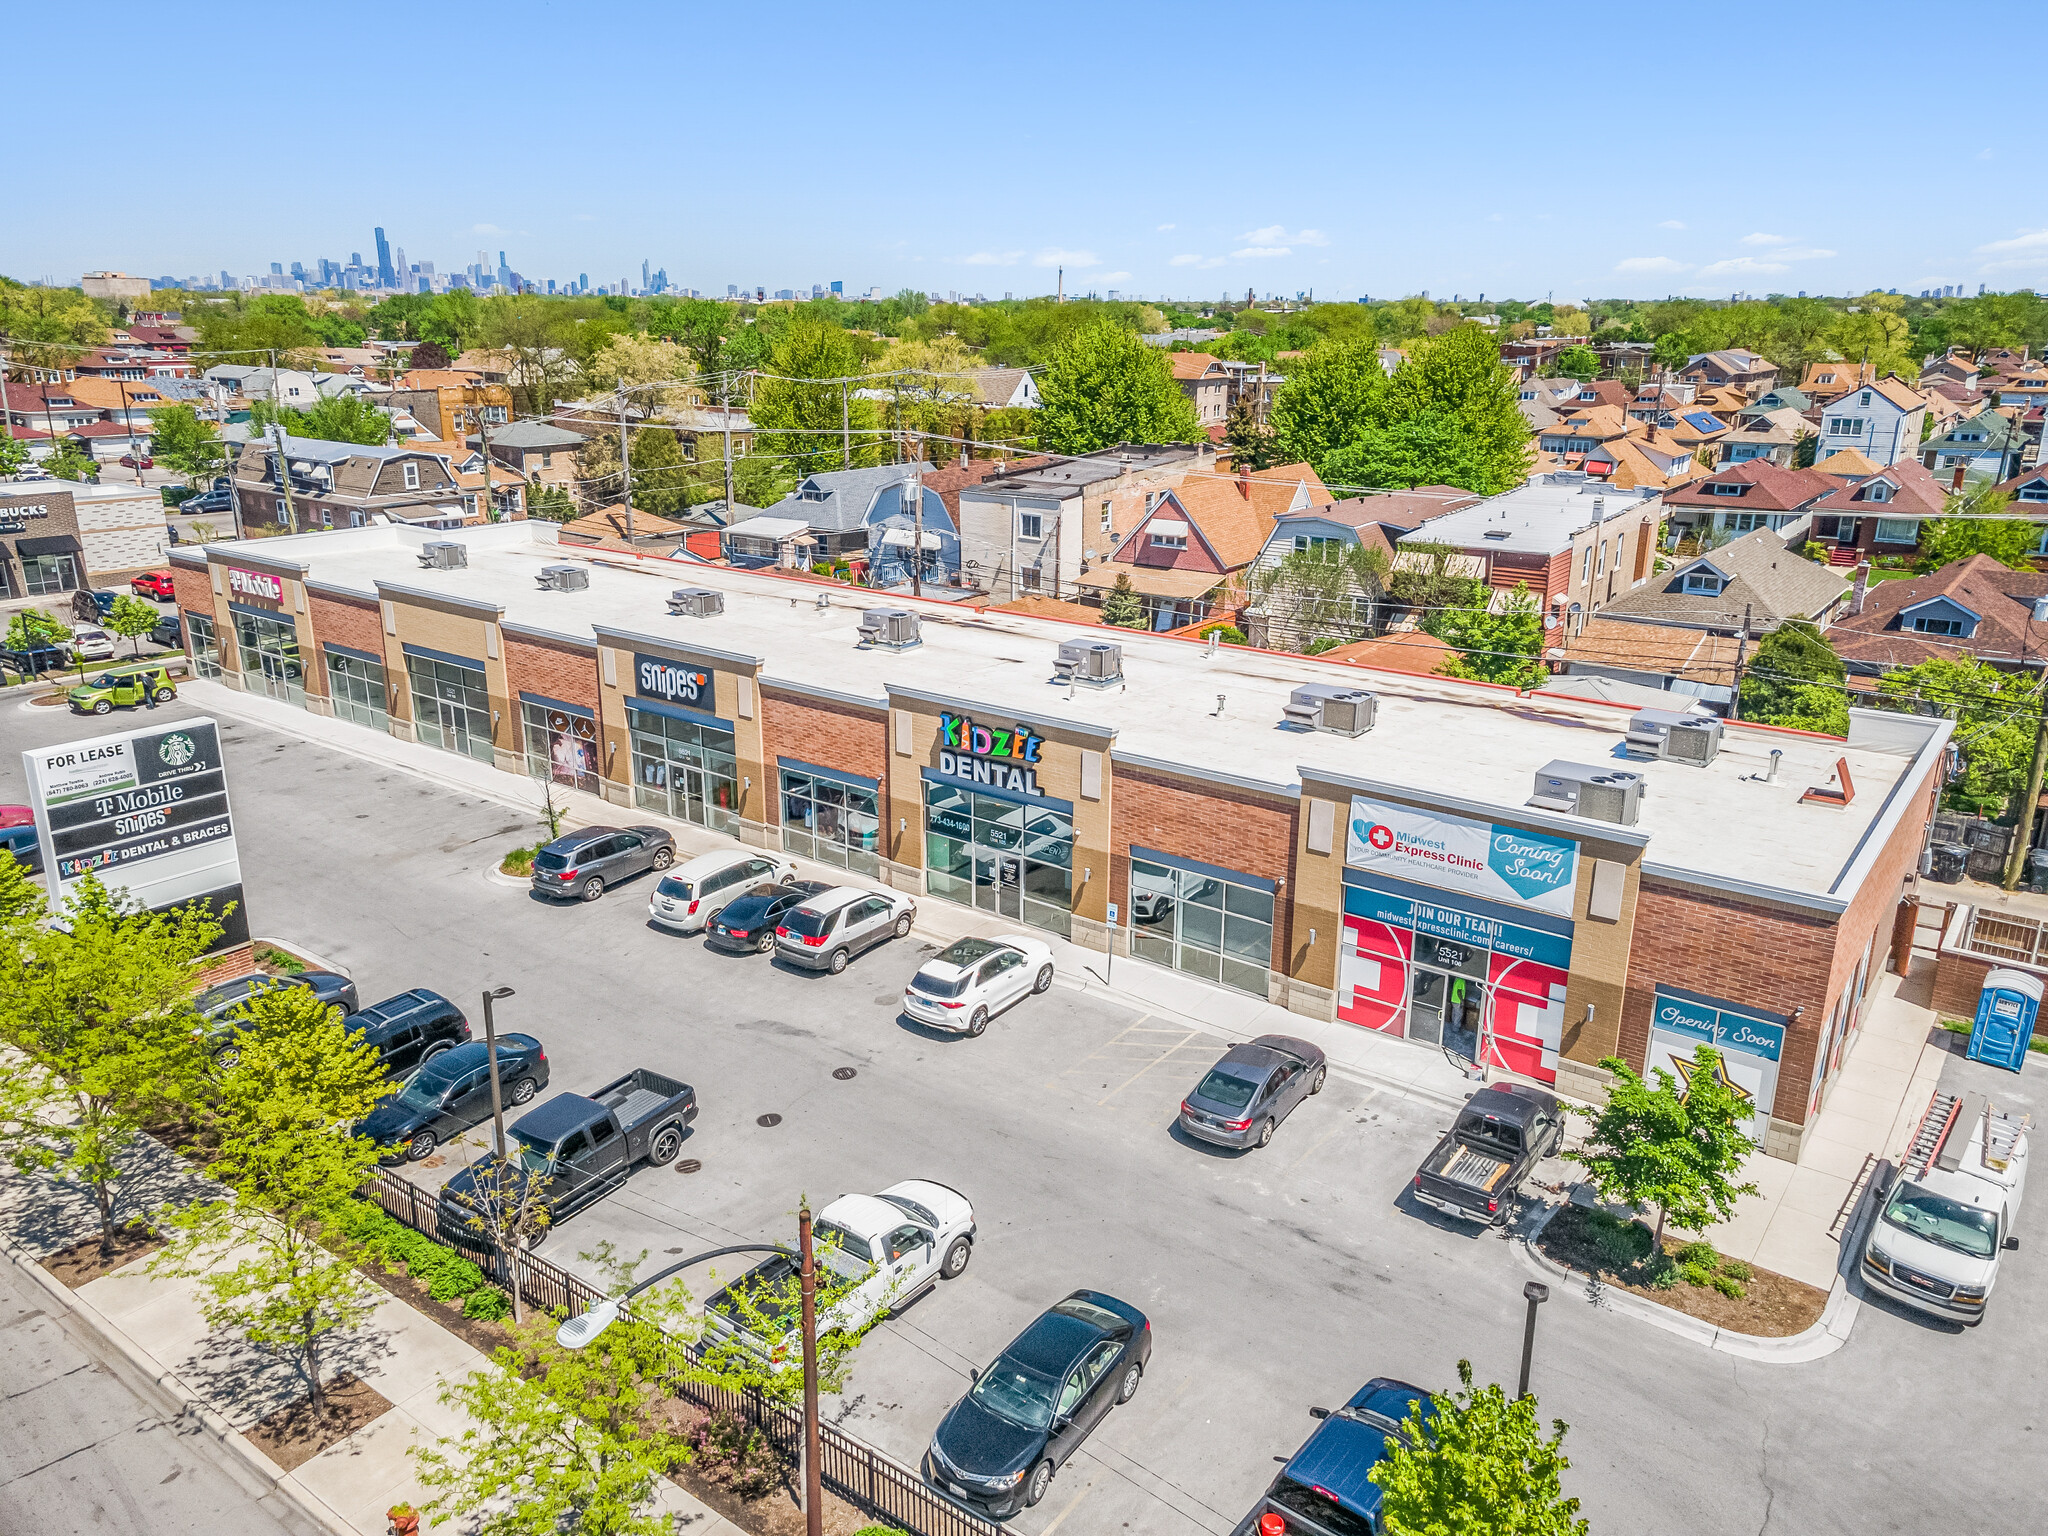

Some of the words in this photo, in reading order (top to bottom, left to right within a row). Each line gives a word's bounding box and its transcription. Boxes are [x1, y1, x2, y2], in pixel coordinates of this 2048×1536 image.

[641, 662, 698, 700] snipes
[940, 711, 1044, 763] KIDZEE
[46, 754, 76, 770] FOR
[80, 744, 124, 763] LEASE
[158, 768, 177, 778] DRIVE
[177, 765, 194, 774] THRU
[939, 749, 1045, 797] DENTAL
[115, 809, 166, 836] snipes
[990, 829, 1007, 840] 5521
[60, 849, 119, 876] KIDZEE
[121, 839, 169, 860] DENTAL
[172, 836, 181, 846] &
[182, 823, 229, 843] BRACES
[1396, 831, 1446, 851] Midwest
[1494, 834, 1564, 868] Coming
[1354, 846, 1370, 854] YOUR
[1370, 849, 1407, 863] COMMUNITY
[1408, 859, 1446, 873] HEALTHCARE
[1447, 868, 1479, 880] PROVIDER
[1395, 842, 1446, 862] Express
[1447, 854, 1484, 871] Clinic
[1505, 858, 1564, 885] Soon!
[1437, 911, 1461, 927] OUR
[1438, 956, 1450, 964] Unit
[1439, 947, 1463, 961] 5521
[1660, 1007, 1728, 1039] Opening
[1732, 1026, 1776, 1049] Soon
